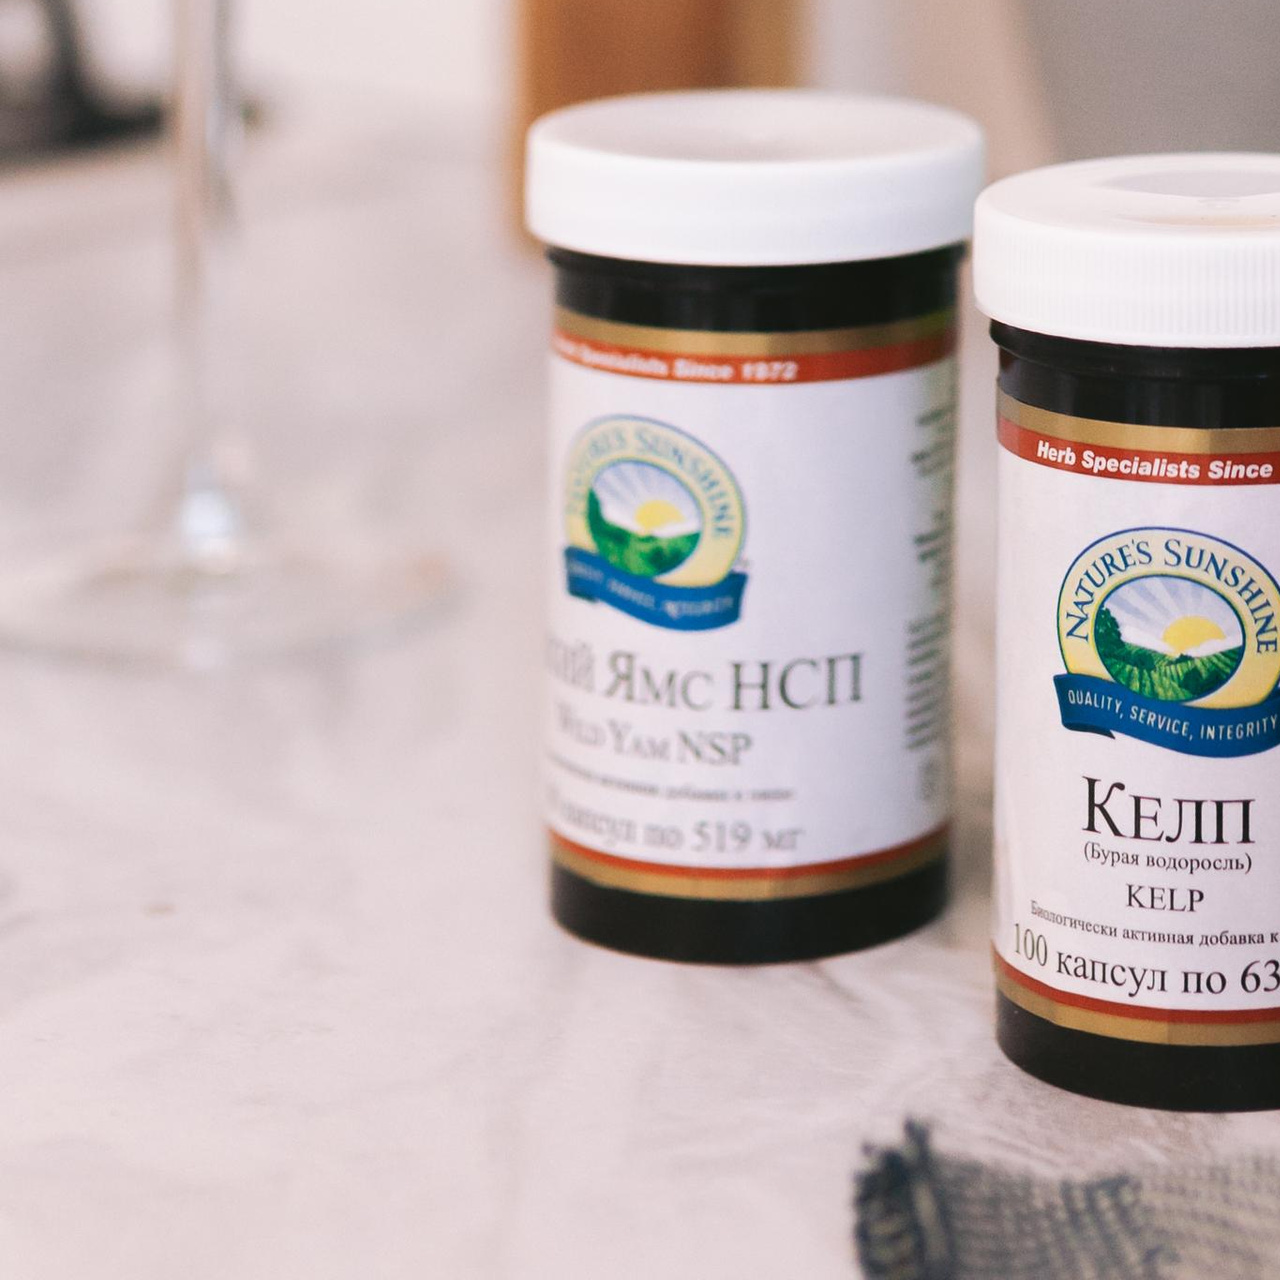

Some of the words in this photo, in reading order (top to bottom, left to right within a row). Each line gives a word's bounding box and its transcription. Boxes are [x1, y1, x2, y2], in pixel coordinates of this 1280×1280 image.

[1037, 440, 1077, 467] Herb
[1081, 450, 1200, 480] Specialists
[1208, 459, 1274, 480] Since
[1065, 539, 1154, 643] NATURE'S
[1163, 538, 1279, 656] SUNSHINE
[1067, 688, 1124, 721] QUALITY,
[1129, 704, 1193, 742] SERVICE,
[1200, 713, 1280, 742] INTEGRITY
[691, 819, 751, 853] 519
[1083, 842, 1140, 867] (Бурая
[1145, 852, 1252, 875] водоросль)
[1125, 883, 1205, 913] KELP
[1030, 899, 1118, 938] Биологически
[1122, 926, 1194, 945] активная
[1199, 929, 1265, 948] добавка
[1270, 931, 1279, 943] к
[1014, 922, 1048, 967] 100
[1056, 951, 1168, 997] капсул
[1181, 968, 1227, 995] по
